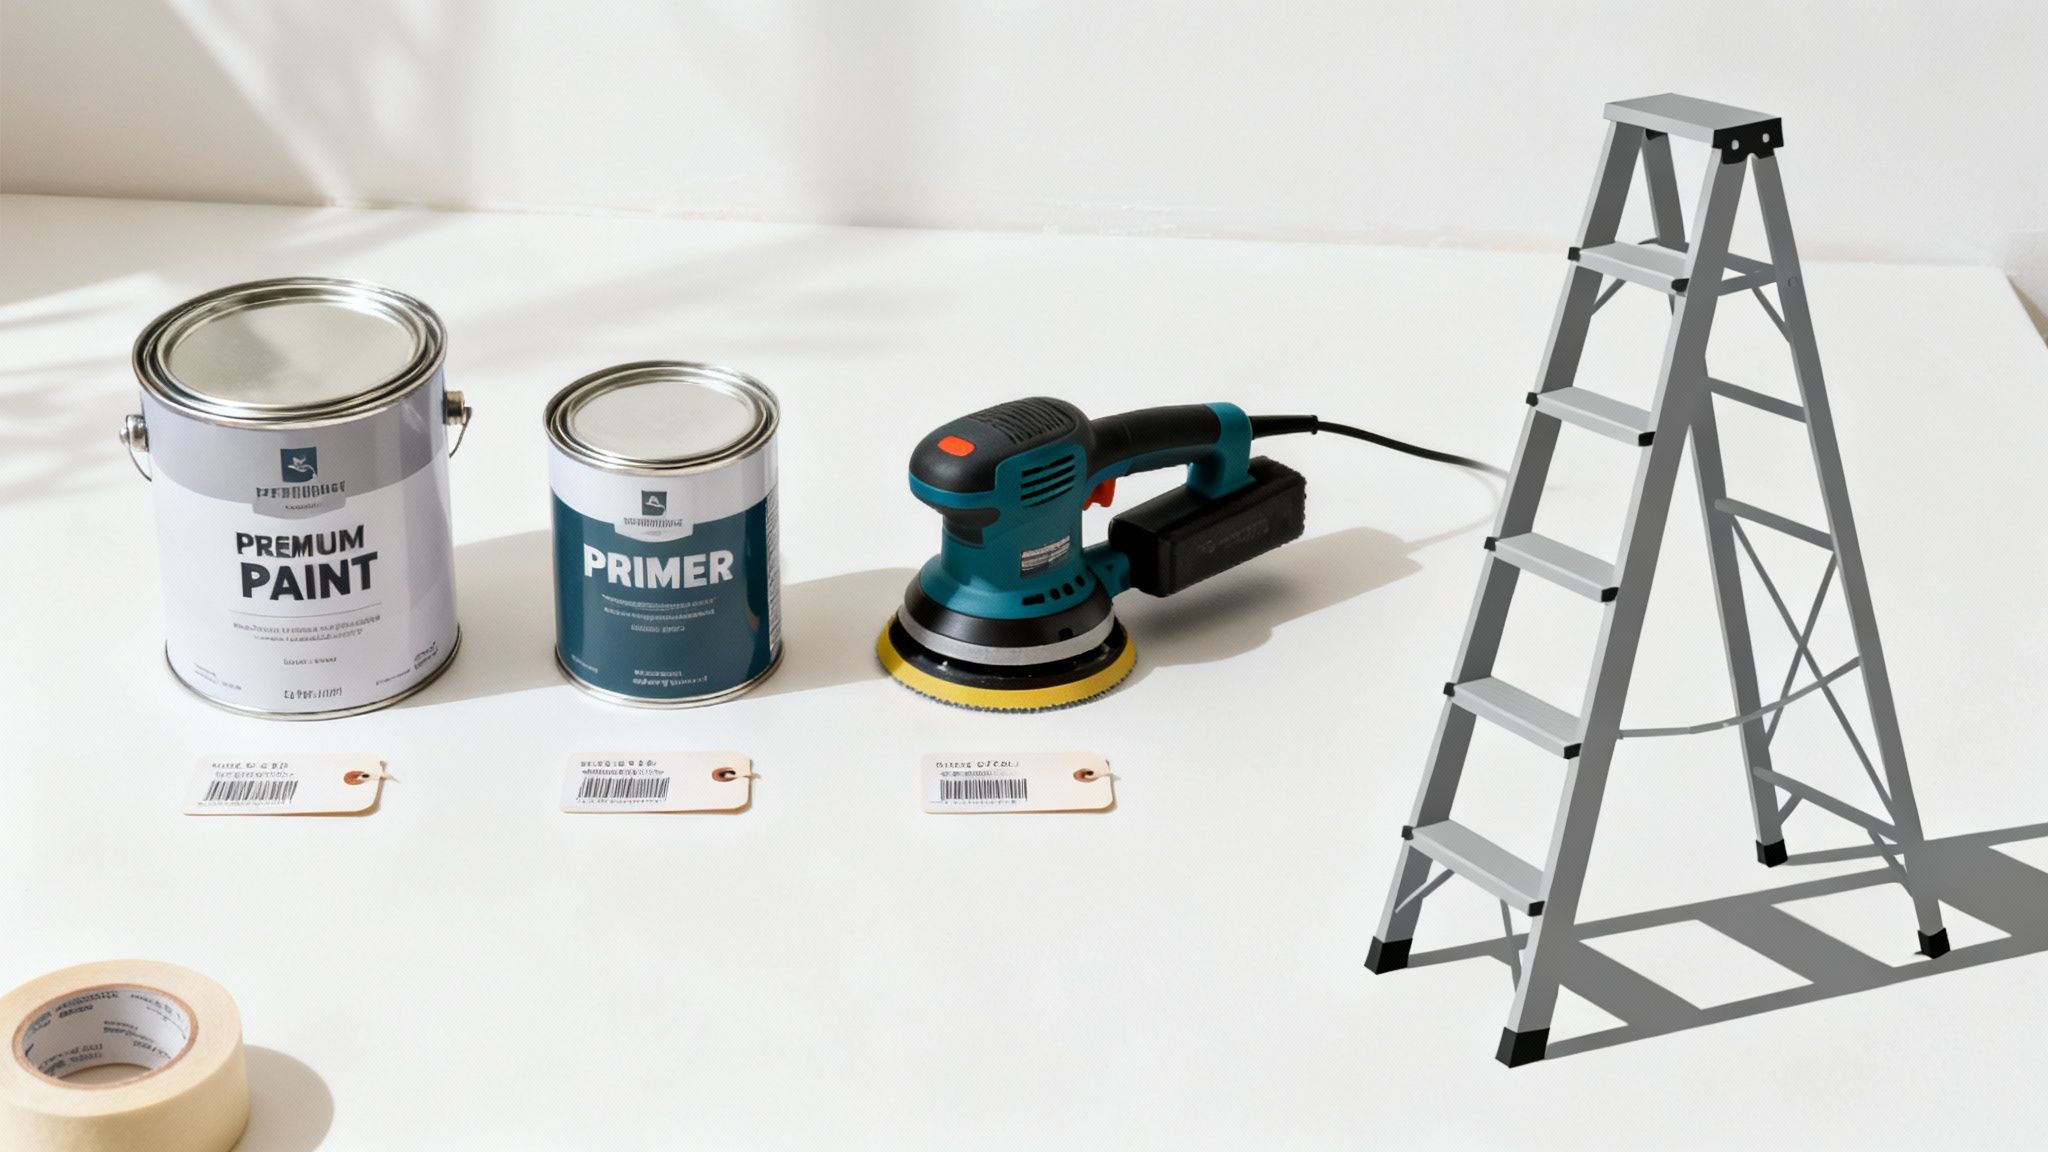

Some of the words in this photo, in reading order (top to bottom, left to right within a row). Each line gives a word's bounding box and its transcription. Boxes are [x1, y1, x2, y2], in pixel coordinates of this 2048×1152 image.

[236, 525, 364, 558] PREMUM
[241, 551, 378, 600] PAINT
[583, 543, 734, 589] PRIMER
